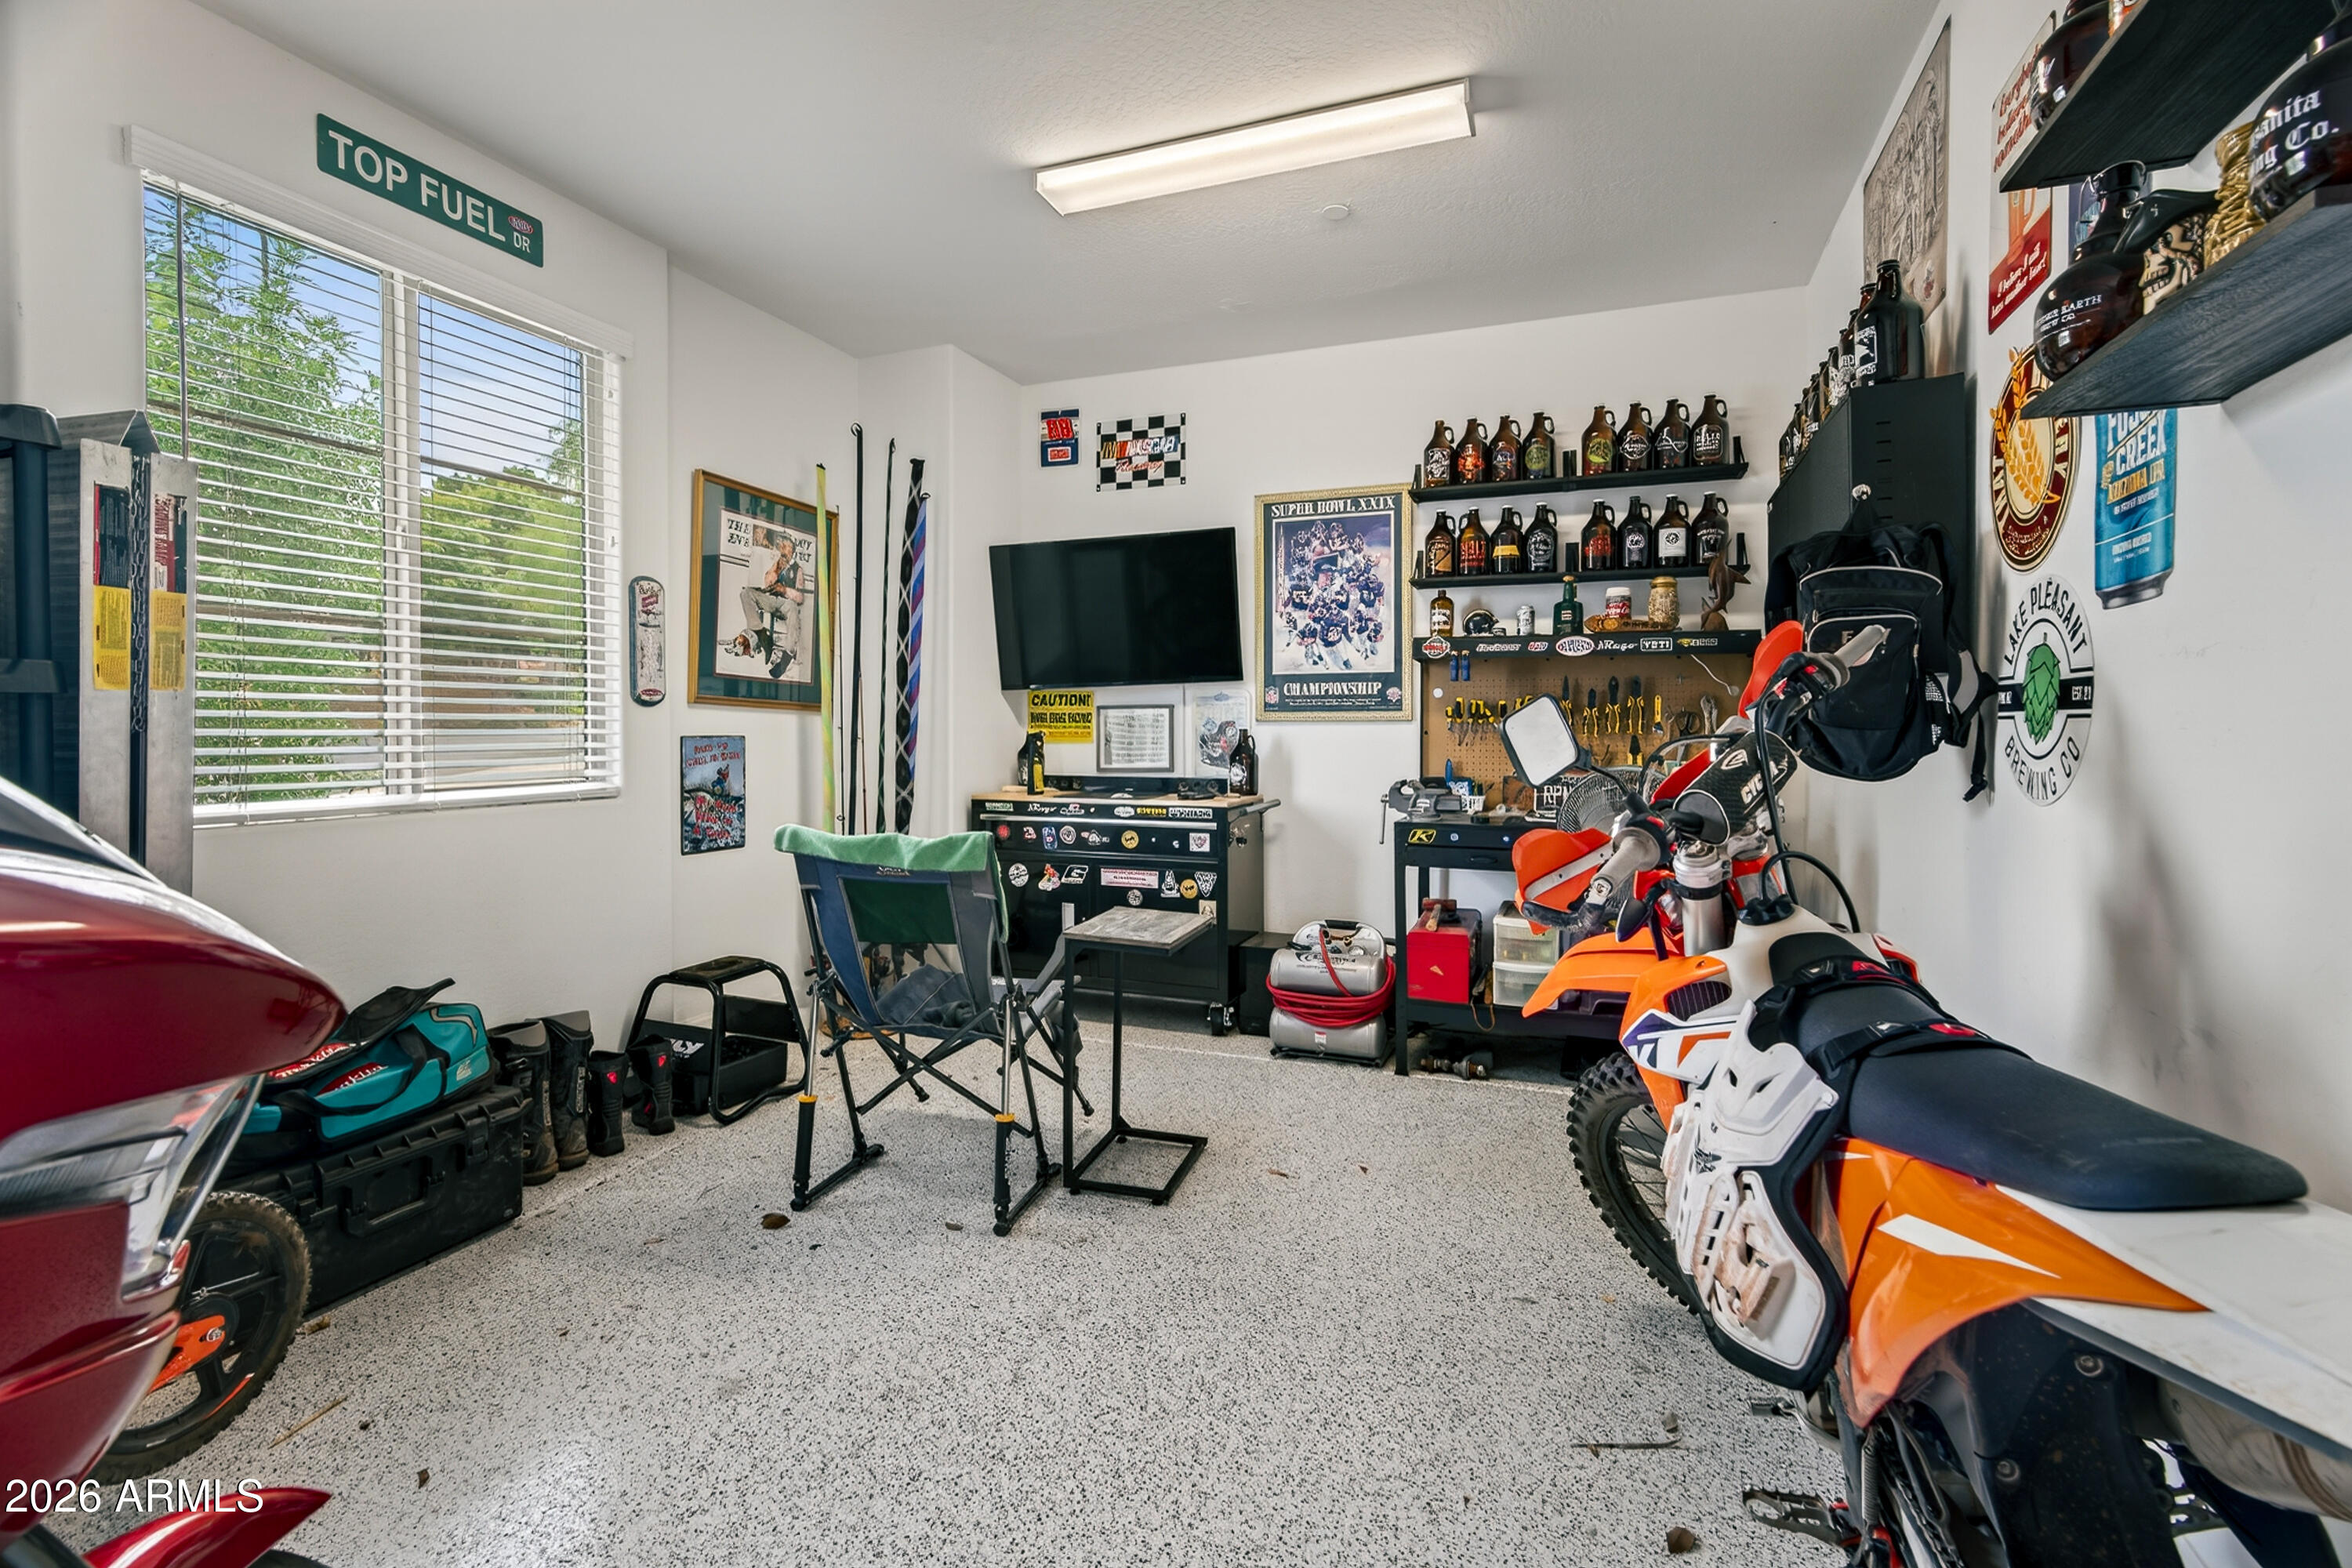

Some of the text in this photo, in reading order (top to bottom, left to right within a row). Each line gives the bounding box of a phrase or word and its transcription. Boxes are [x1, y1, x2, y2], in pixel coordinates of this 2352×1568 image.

[2285, 120, 2339, 151] Co.
[328, 129, 506, 242] TOP FUEL
[513, 231, 531, 253] DR
[1271, 501, 1316, 518] SUPER
[1317, 499, 1356, 514] BOWL
[2004, 577, 2088, 665] LAKE PLEASANT
[1283, 681, 1382, 696] CHAMPIONSHIP
[2005, 735, 2057, 800] BREWING
